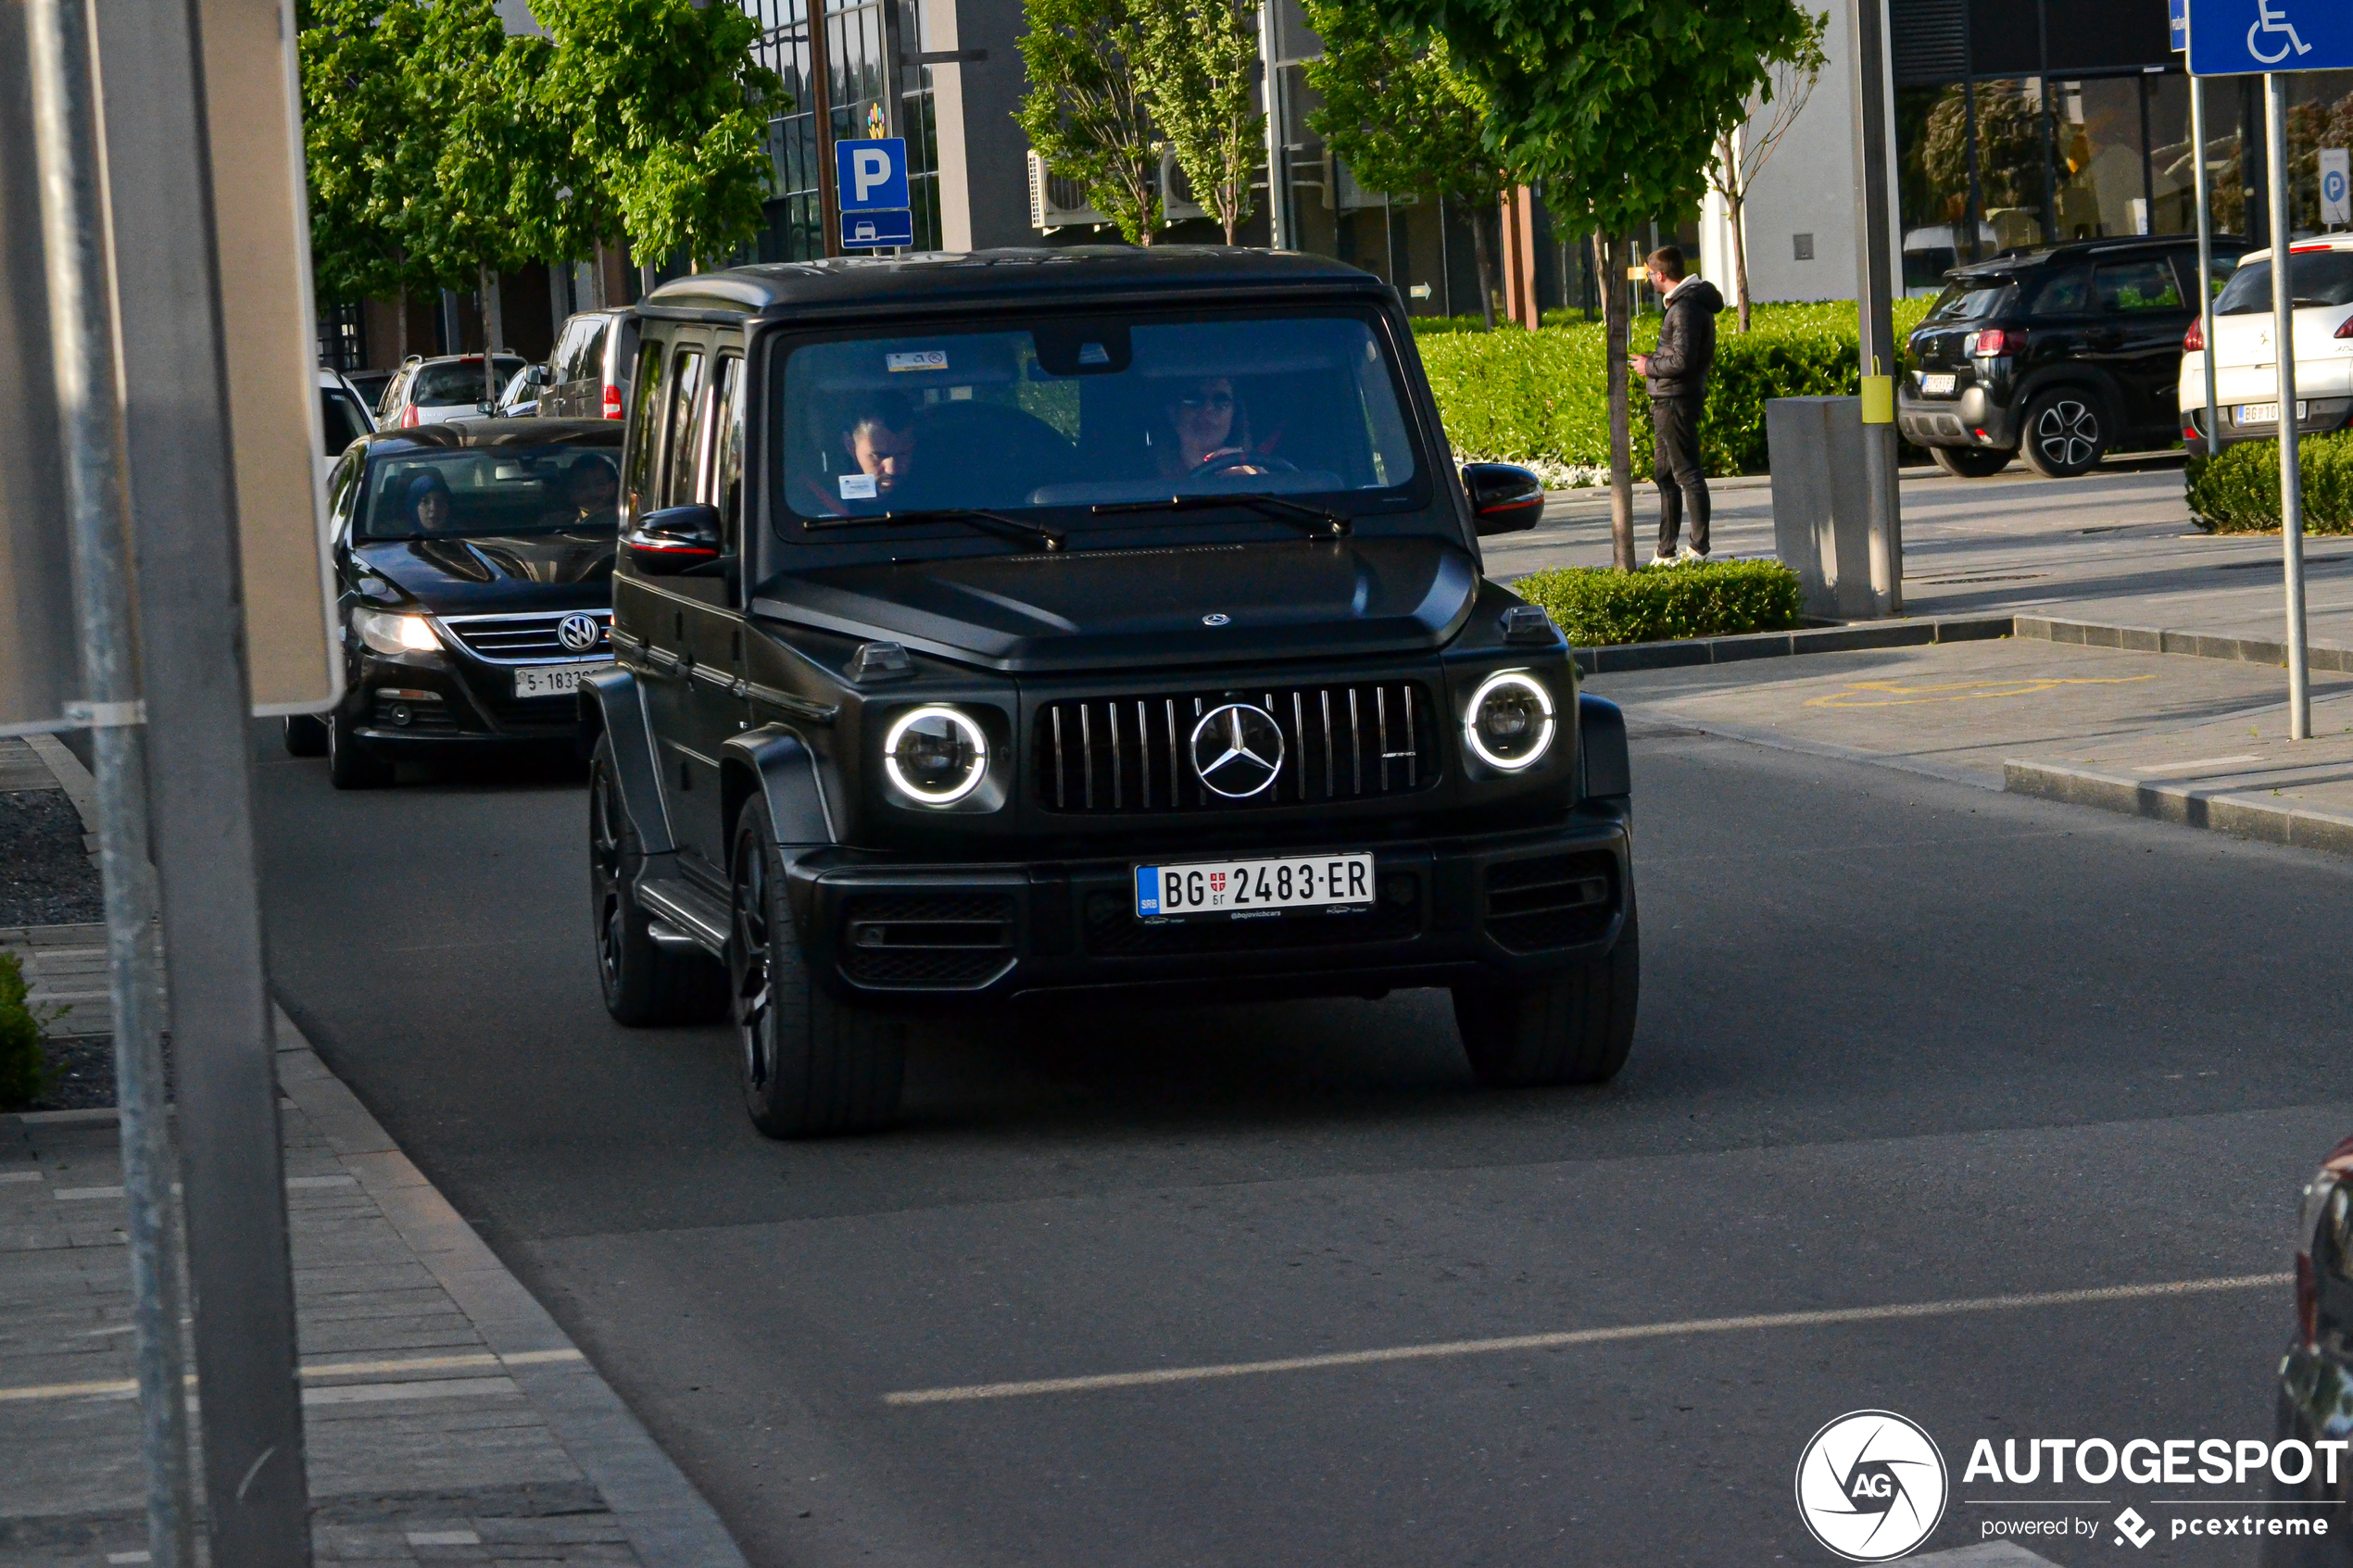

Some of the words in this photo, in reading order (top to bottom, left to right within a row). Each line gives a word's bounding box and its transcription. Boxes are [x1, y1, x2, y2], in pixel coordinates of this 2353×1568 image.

[852, 147, 892, 202] P
[2330, 177, 2340, 198] P
[2246, 407, 2258, 420] BG
[1164, 871, 1204, 908] BG
[1140, 898, 1158, 909] SRB
